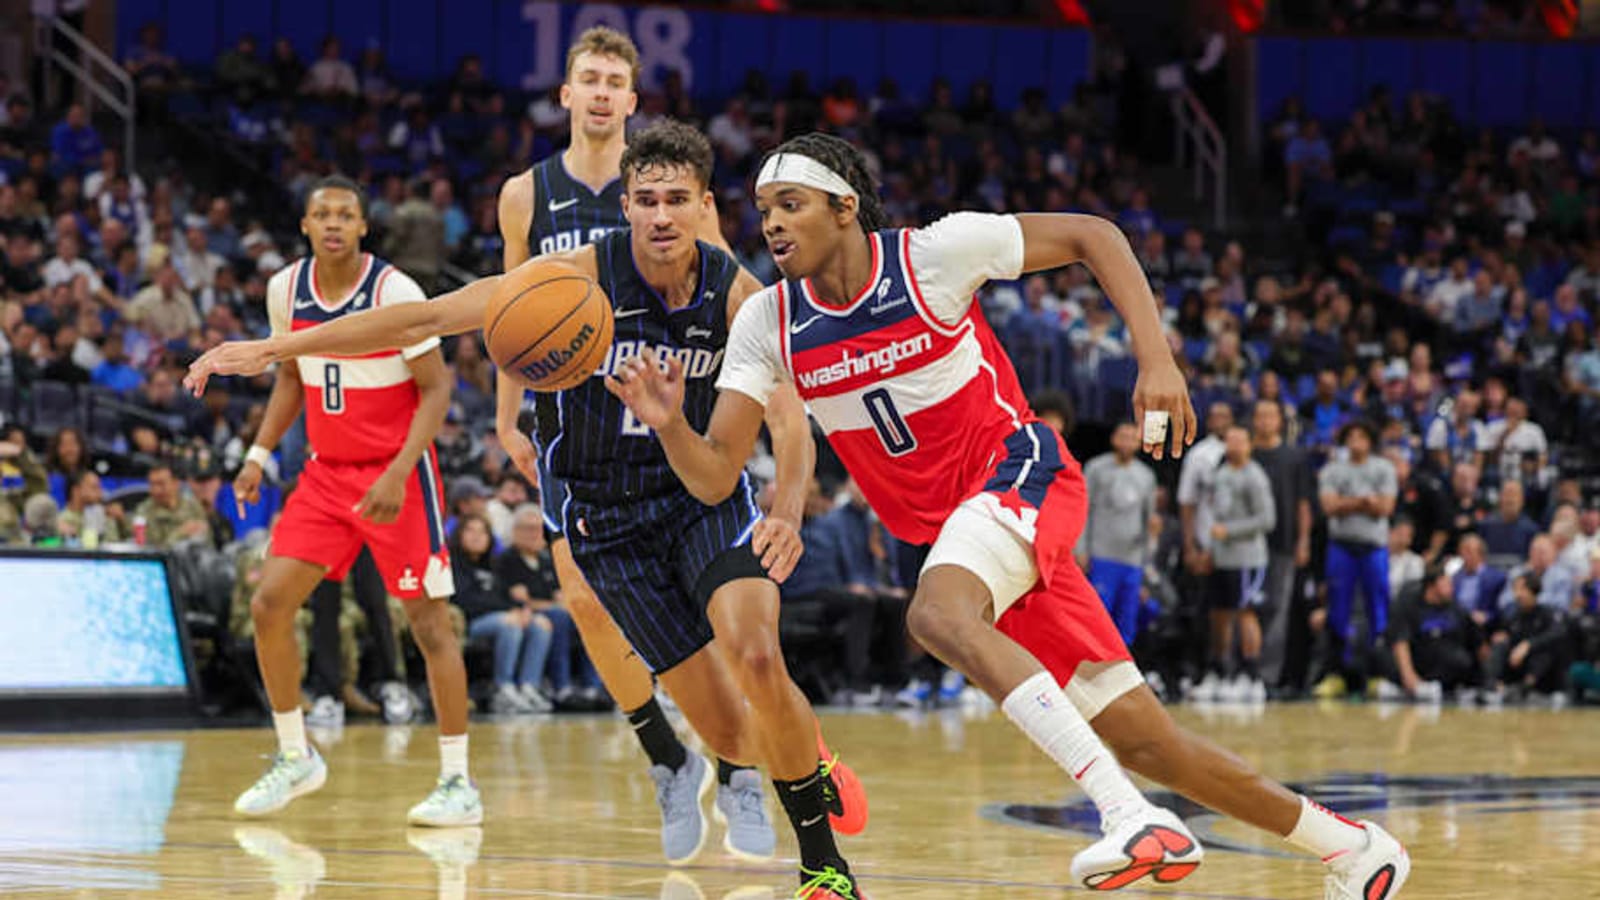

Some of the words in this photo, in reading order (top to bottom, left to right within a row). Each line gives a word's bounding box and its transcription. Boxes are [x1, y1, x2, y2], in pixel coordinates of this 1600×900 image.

[519, 323, 595, 382] Wilson
[797, 332, 933, 390] washington
[324, 362, 345, 414] 8
[862, 387, 918, 457] 0
